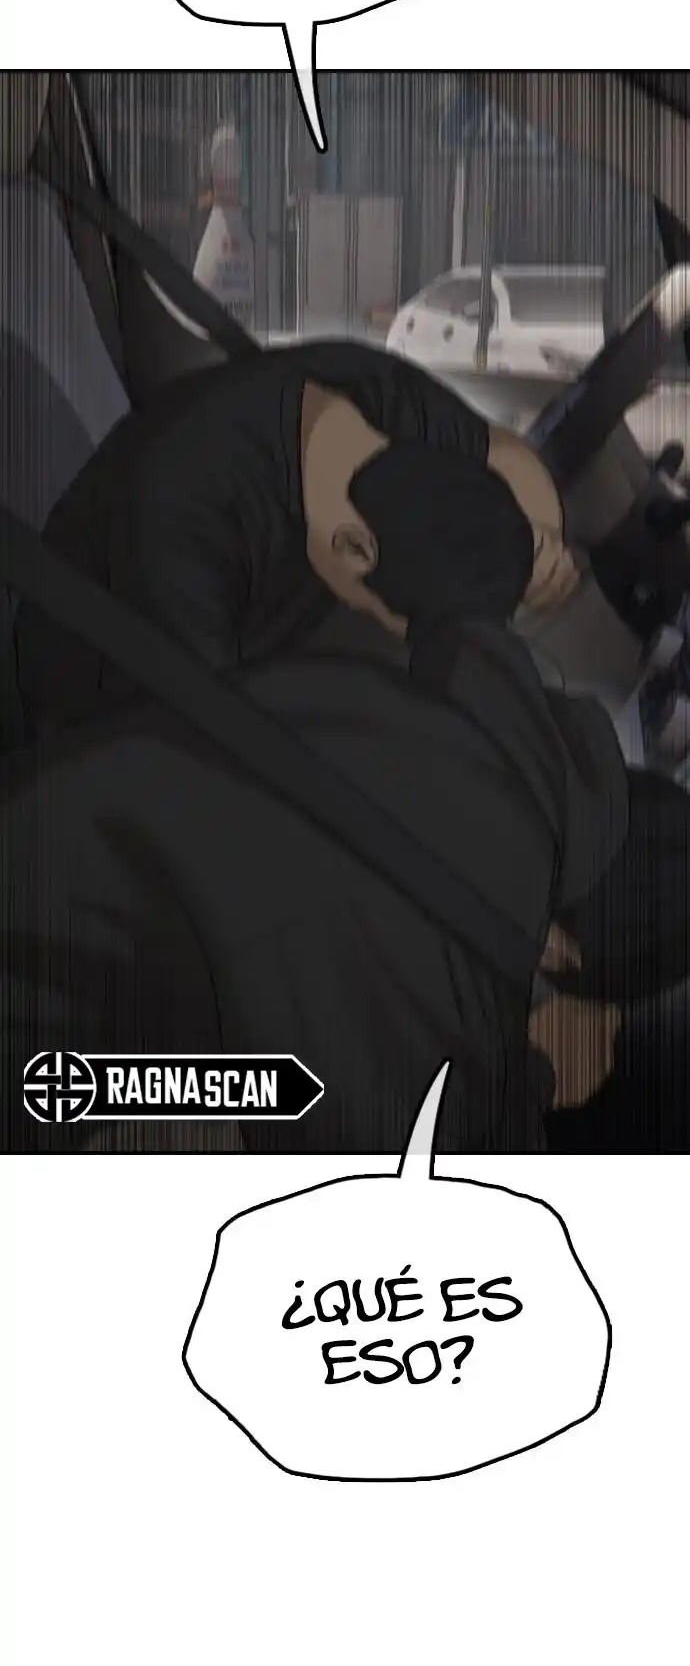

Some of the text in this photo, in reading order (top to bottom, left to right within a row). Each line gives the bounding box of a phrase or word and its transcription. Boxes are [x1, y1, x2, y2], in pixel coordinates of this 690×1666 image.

[281, 1264, 523, 1330] ¿QUÉ ES
[321, 1334, 475, 1385] ESO?
